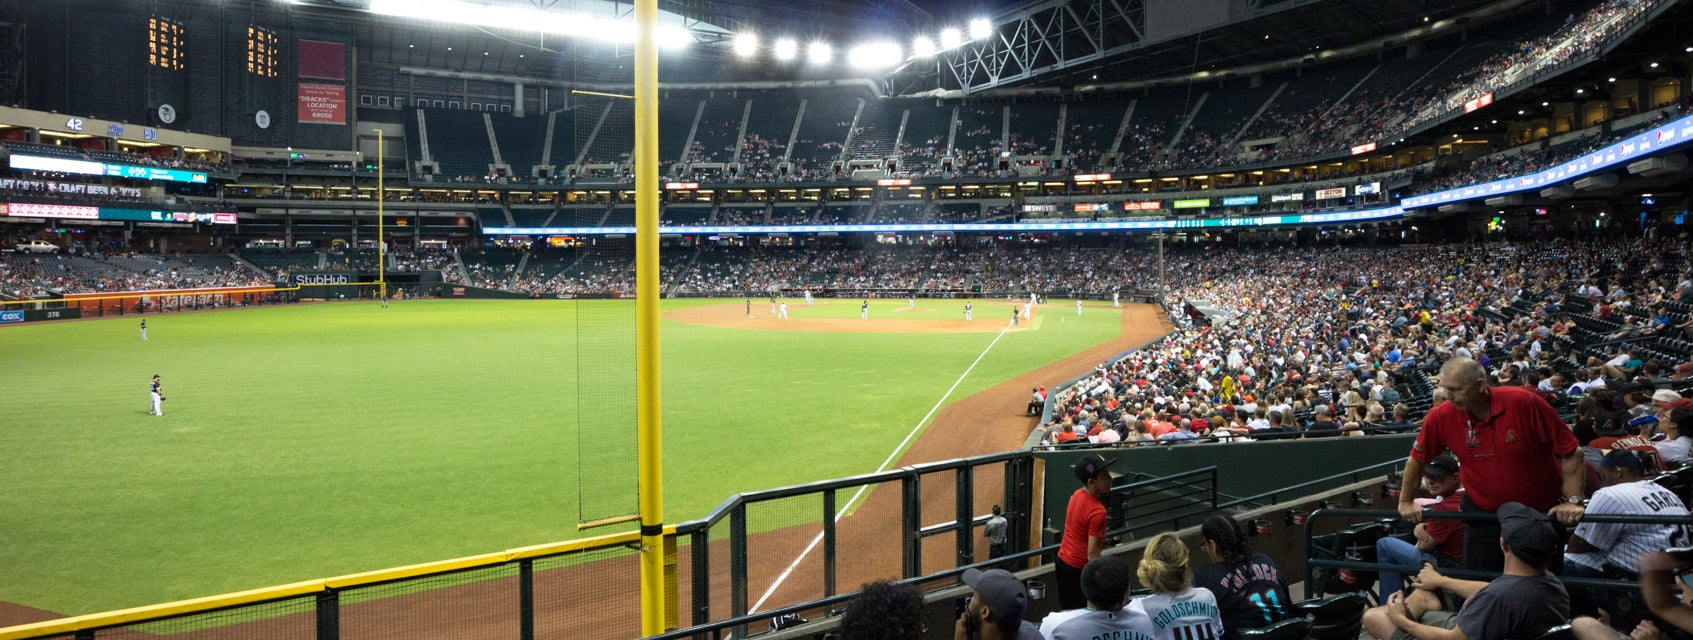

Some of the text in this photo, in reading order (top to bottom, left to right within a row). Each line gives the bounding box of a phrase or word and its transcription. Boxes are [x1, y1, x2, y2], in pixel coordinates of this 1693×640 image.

[66, 118, 82, 130] 42
[108, 123, 124, 136] 20
[144, 128, 157, 140] 51
[59, 183, 86, 194] CRAFT
[87, 185, 108, 195] BEER
[296, 274, 347, 285] StubHub
[1247, 588, 1285, 622] 11
